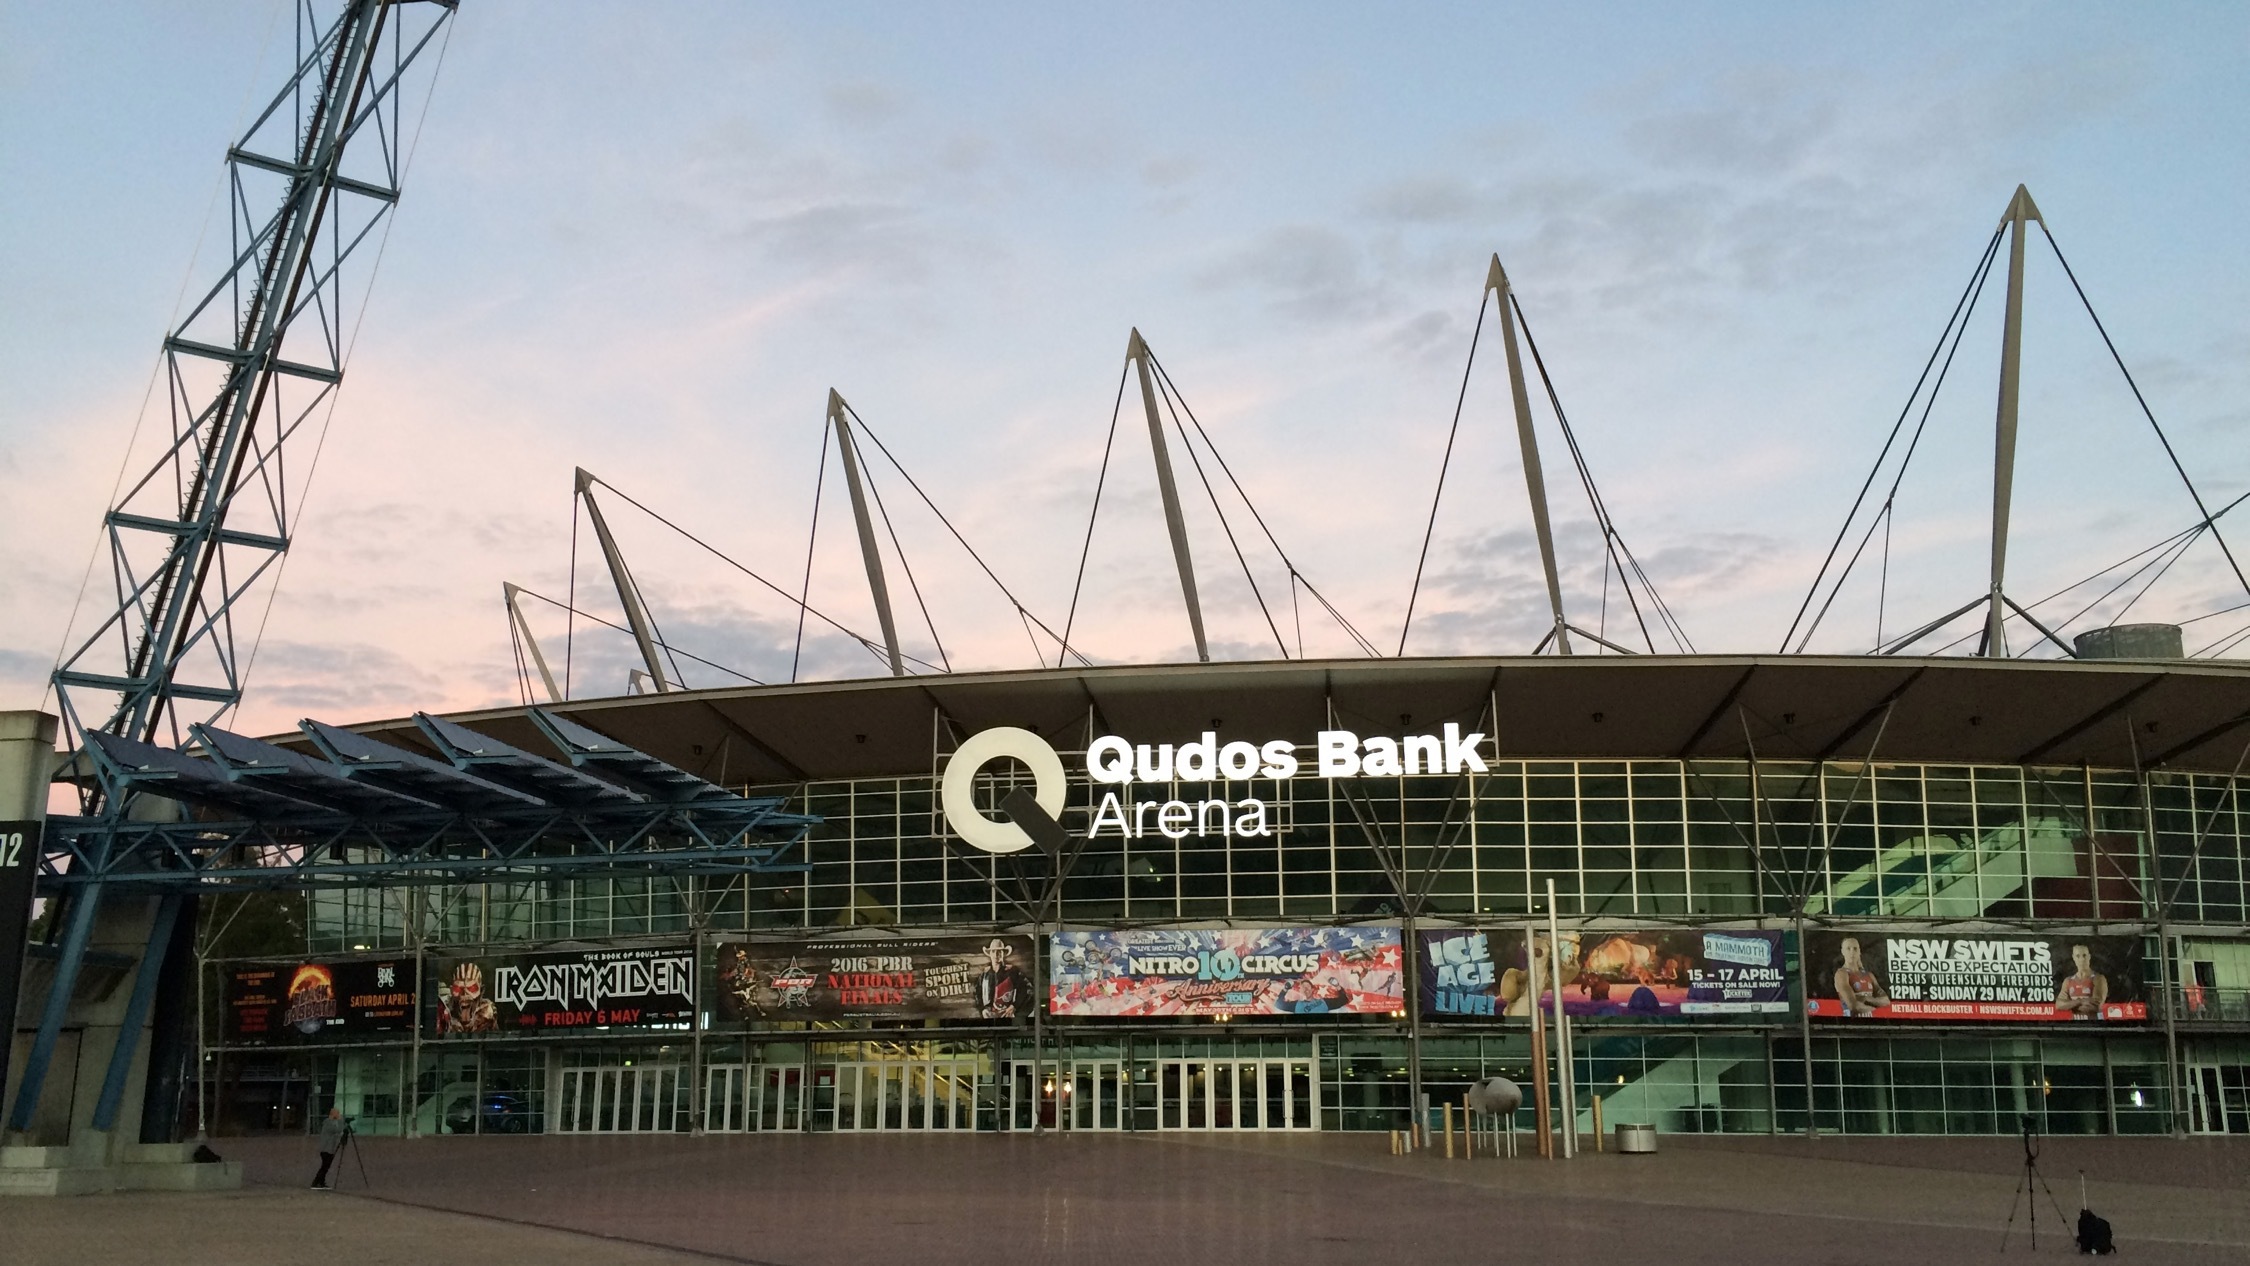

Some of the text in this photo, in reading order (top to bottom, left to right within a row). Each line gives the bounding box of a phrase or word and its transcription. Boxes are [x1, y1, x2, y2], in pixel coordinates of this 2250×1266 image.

[1086, 723, 1489, 785] Qudos Bank
[1088, 791, 1271, 839] Arena
[602, 953, 621, 961] BOOK
[623, 952, 633, 960] OF
[636, 951, 660, 959] SOULS
[1428, 933, 1490, 966] ICE
[1706, 941, 1712, 951] A
[1715, 941, 1765, 958] MAMMOTH
[1886, 939, 2051, 961] NSW SWIFTS
[831, 956, 913, 973] 2016 PBR
[924, 963, 969, 976] TOUGHEST
[1129, 955, 1199, 975] NITRO
[1241, 954, 1320, 975] CIRCUS
[1890, 960, 2050, 973] BEYOND EXPECTATION
[774, 978, 813, 986] PBR
[827, 972, 915, 989] NATIONAL
[925, 971, 970, 988] SPORT
[1437, 962, 1496, 989] AGE
[1687, 969, 1703, 981] 15
[1718, 969, 1734, 981] 17
[1738, 968, 1784, 980] APRIL
[1888, 973, 2054, 987] VERSUS QUEENSLAND FIREBIRDS
[495, 957, 694, 1012] IRON MAIDEN
[926, 983, 971, 997] ON DIRT
[1168, 978, 1271, 999] Anniversary
[350, 994, 387, 1007] SATURDAY
[388, 993, 410, 1006] APRIL
[840, 990, 903, 1005] FINALS
[1435, 990, 1495, 1015] LIVE!
[1889, 985, 1921, 999] 12PM
[1929, 986, 1977, 1000] SUNDAY
[1980, 987, 1994, 1001] 29
[1996, 987, 2025, 1003] MAY,
[2027, 987, 2055, 1002] 2016
[544, 1011, 592, 1025] FRIDAY
[597, 1009, 606, 1024] 6
[611, 1009, 640, 1023] MAY
[1891, 1004, 2054, 1015] NETBALL BLOCKBUSTER NSWSWIFTS.COM.AU
